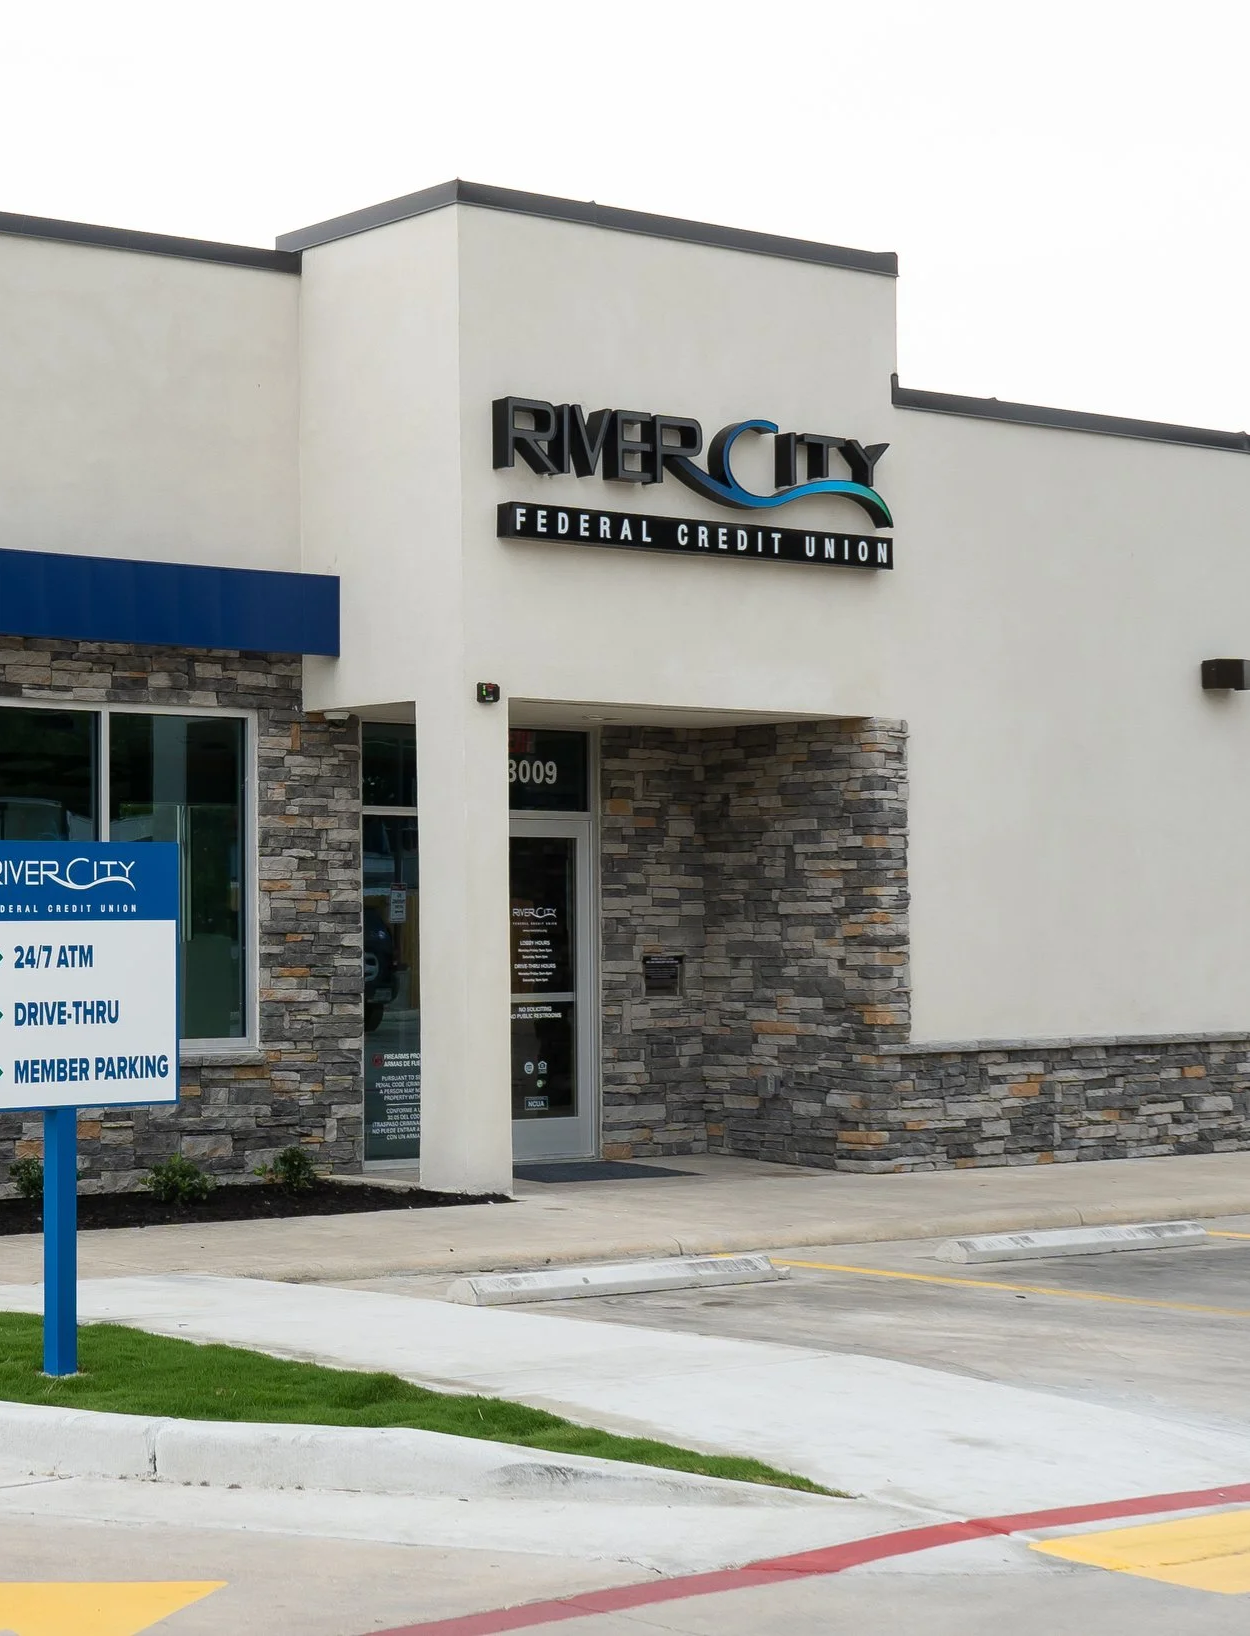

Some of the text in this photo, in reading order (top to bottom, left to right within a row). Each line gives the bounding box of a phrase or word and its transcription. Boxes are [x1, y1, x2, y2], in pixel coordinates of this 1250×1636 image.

[493, 396, 891, 508] RIVER CITY
[515, 507, 888, 564] FEDERAL CREDIT UNION
[509, 759, 557, 784] 3009
[66, 857, 136, 890] CITY
[47, 904, 92, 913] CREDIT
[100, 904, 138, 913] UNION
[513, 908, 535, 917] RIVER
[13, 945, 94, 969] 24/7 ATM
[14, 1000, 120, 1027] DRIVE-THRU
[14, 1054, 169, 1084] MEMBER PARKING
